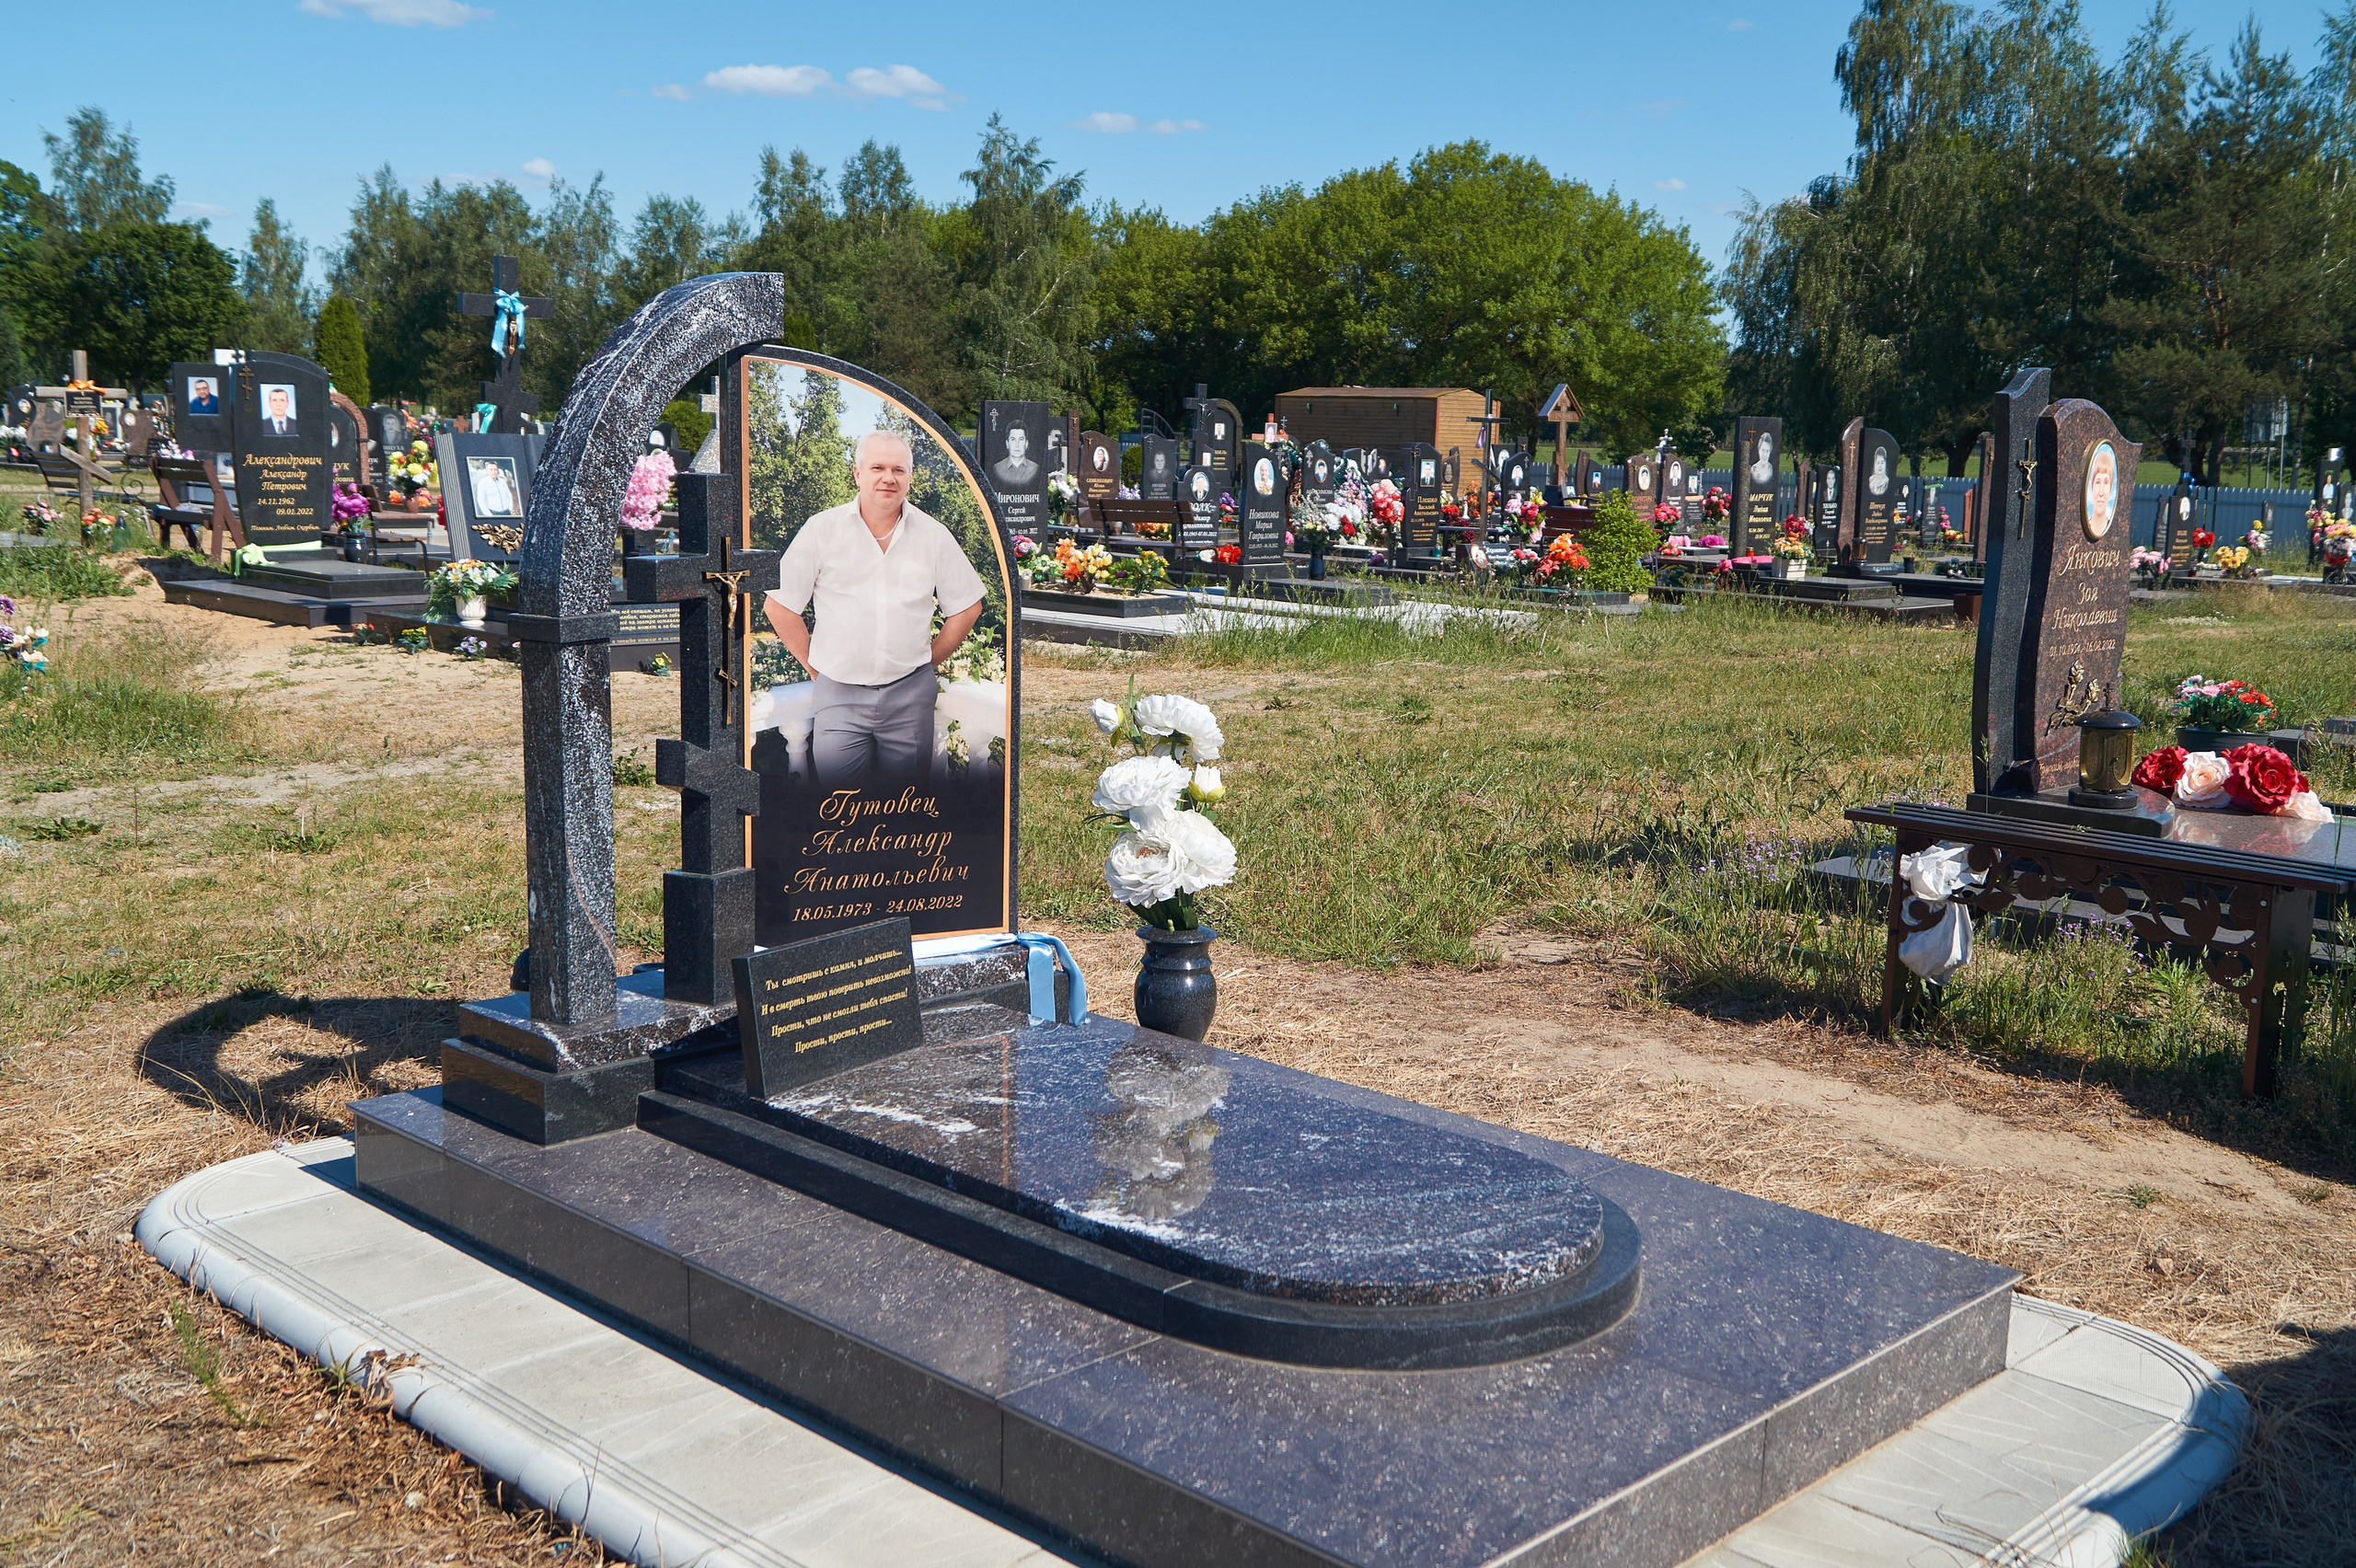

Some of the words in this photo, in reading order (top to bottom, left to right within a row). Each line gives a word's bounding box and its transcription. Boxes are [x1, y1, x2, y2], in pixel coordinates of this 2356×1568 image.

[242, 452, 322, 469] Александрович
[259, 467, 307, 481] Александр
[261, 481, 307, 493] Петрович
[1008, 506, 1026, 515] Сергей
[1248, 508, 1279, 519] Новикова
[1248, 530, 1279, 541] Гавриловна
[1254, 520, 1273, 531] Мария
[2059, 543, 2120, 575] Янкович
[2077, 582, 2098, 605] Зоя
[2051, 607, 2118, 632] Николаевна
[819, 786, 939, 826] Гутовец
[802, 824, 953, 857] Александр
[783, 856, 970, 894] Анатольевич
[792, 902, 872, 922] 18.05.1973
[885, 894, 964, 914] 24.08.2022
[766, 979, 779, 991] Ты
[782, 972, 824, 986] смотришь
[830, 963, 857, 974] камня,
[864, 949, 903, 964] молчишь...
[761, 1005, 768, 1016] И
[776, 997, 805, 1011] смерть
[806, 992, 827, 1003] твою
[828, 981, 864, 997] поверить
[865, 964, 912, 986] невозможно!
[771, 1021, 804, 1037] Прости,
[805, 1016, 821, 1027] что
[823, 1012, 832, 1020] не
[833, 1005, 859, 1019] смогли
[860, 998, 878, 1010] тебя
[879, 986, 908, 1006] спасти!
[794, 1039, 827, 1054] Прости,
[828, 1029, 858, 1044] прости,
[859, 1019, 893, 1034] прости...
